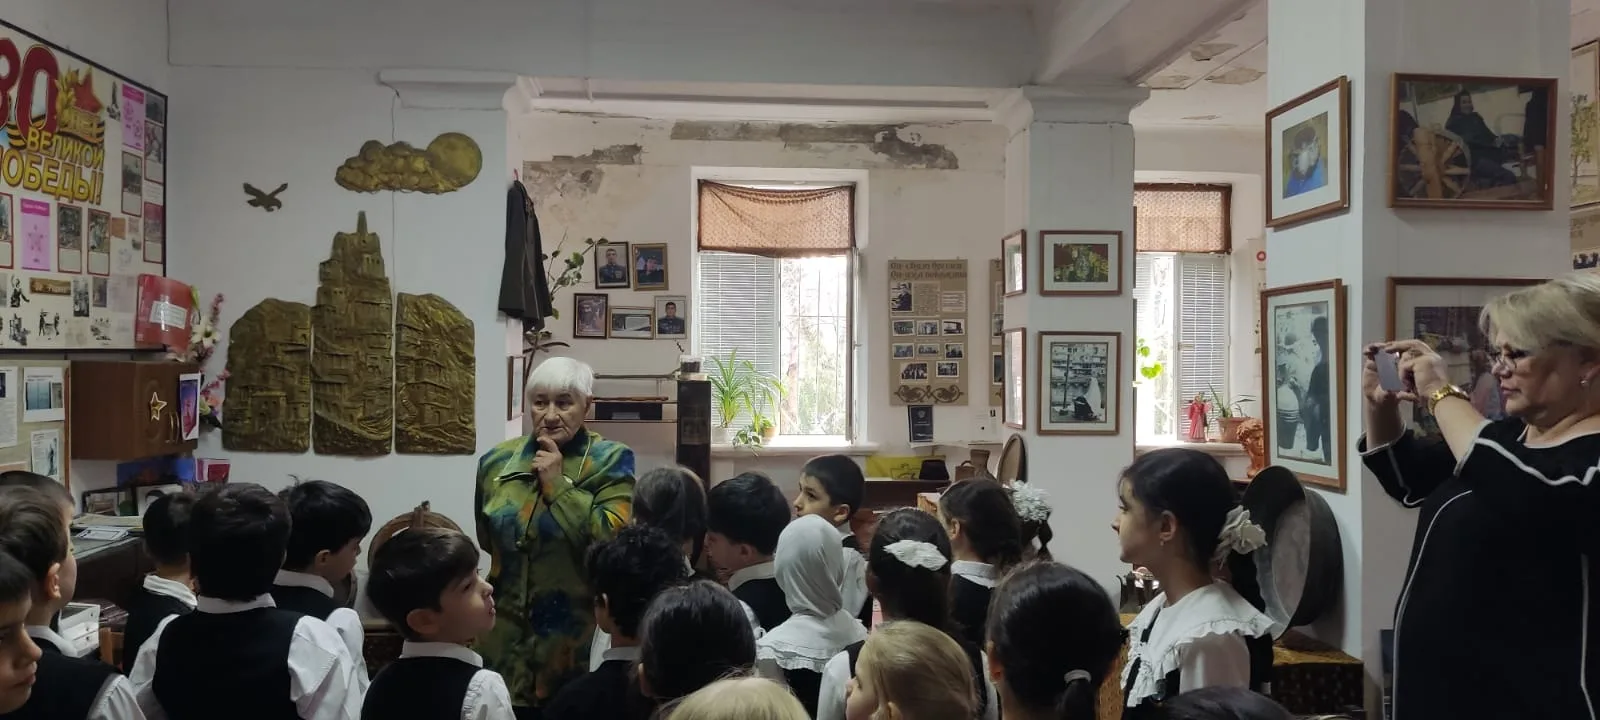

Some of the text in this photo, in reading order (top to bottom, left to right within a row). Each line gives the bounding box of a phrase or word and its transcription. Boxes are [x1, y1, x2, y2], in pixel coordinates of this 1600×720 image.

[0, 37, 59, 142] 80
[0, 144, 104, 205] ОБЕДЫ!
[27, 126, 105, 171] ВЕЛИКОЙ
